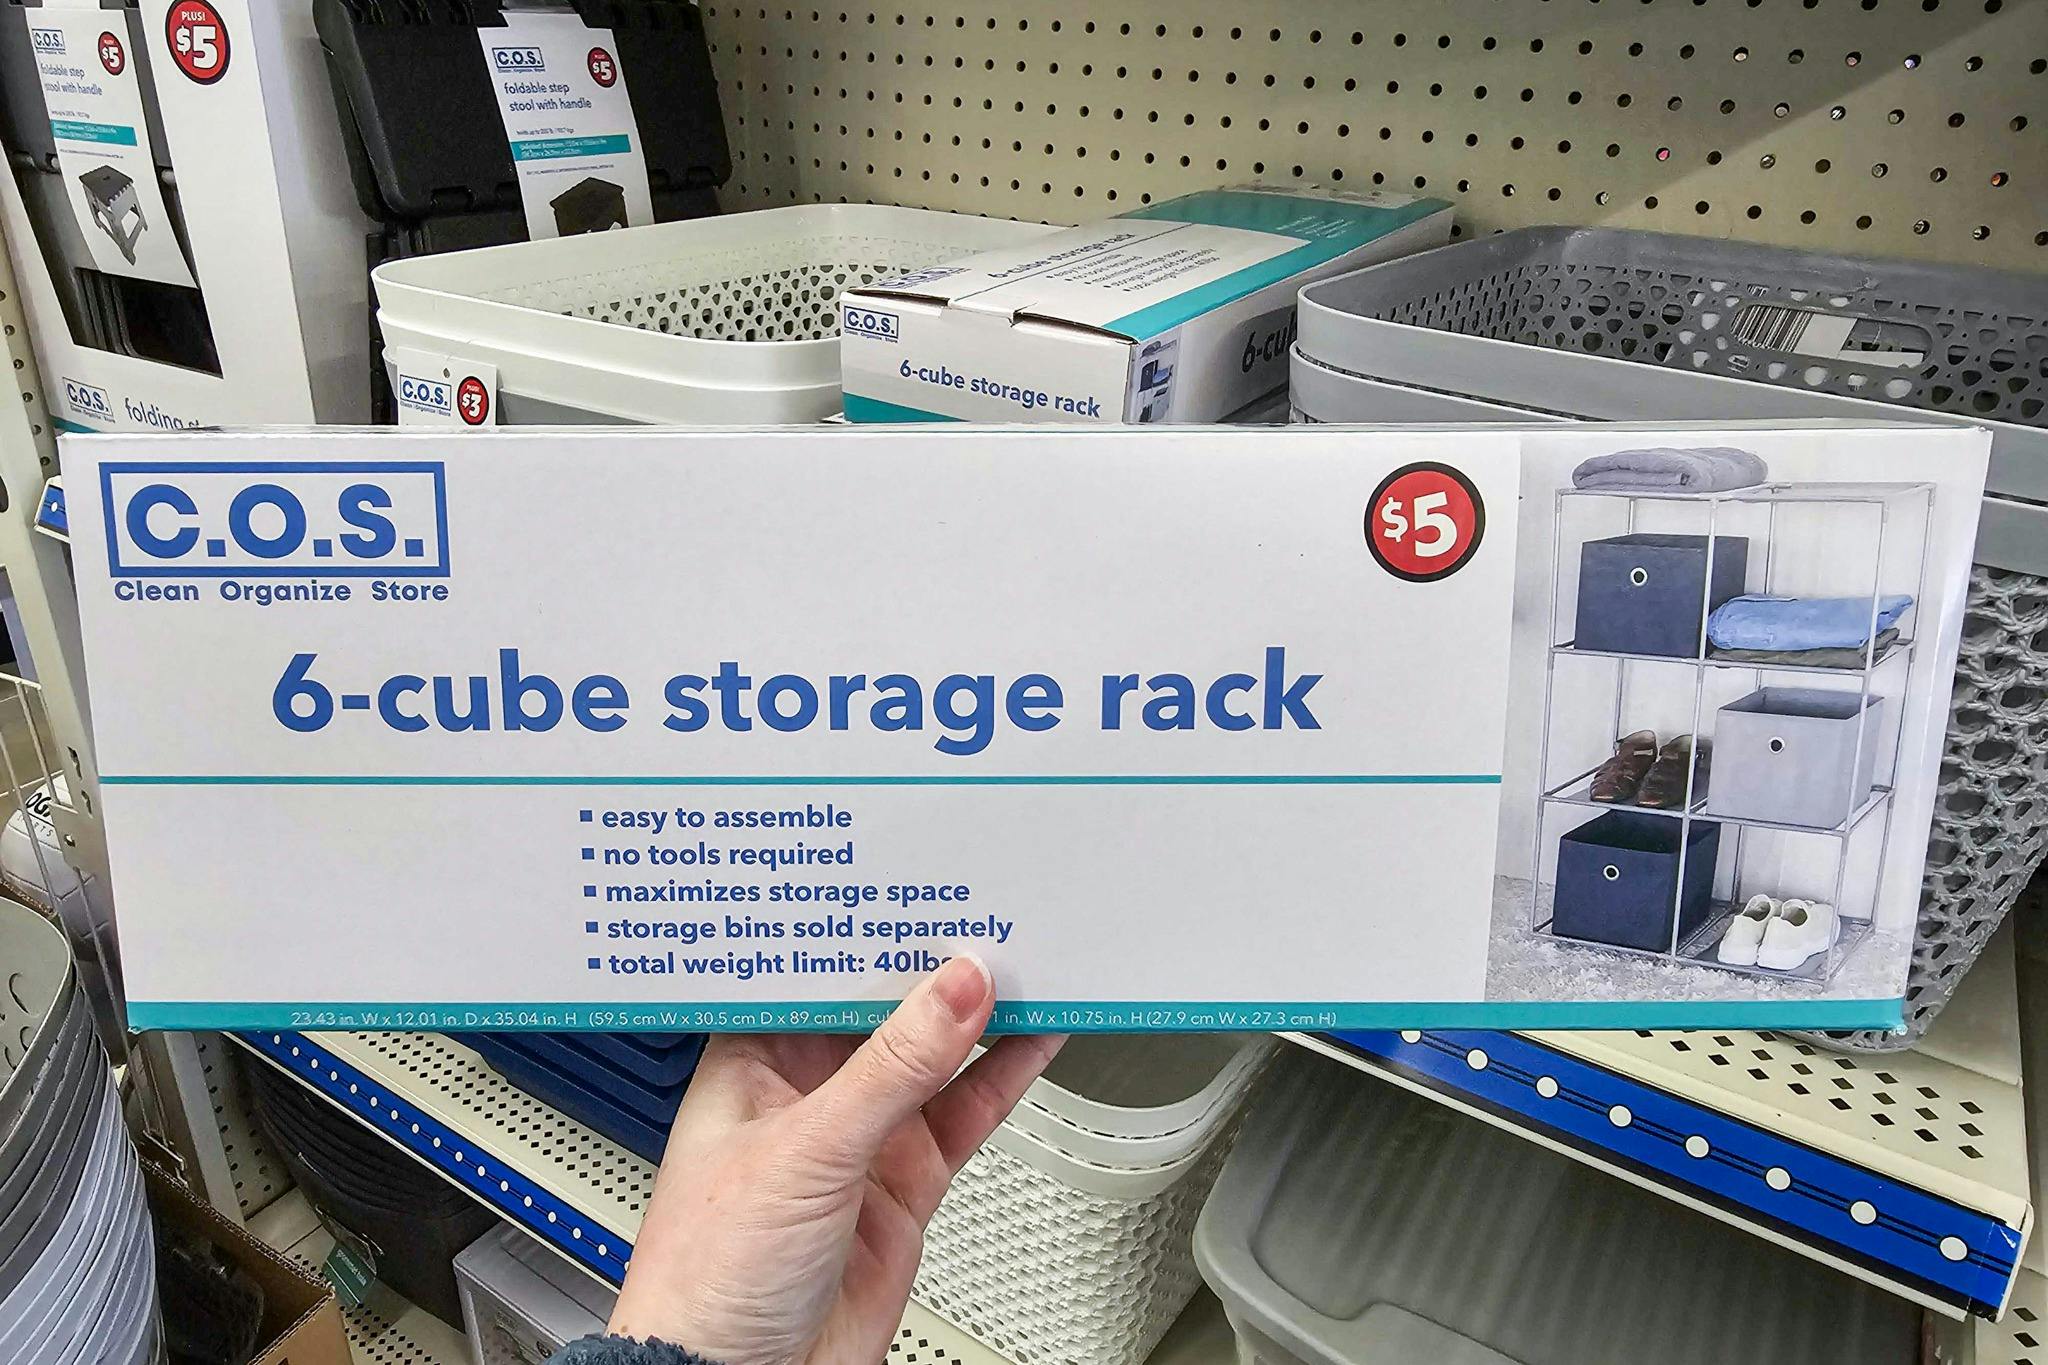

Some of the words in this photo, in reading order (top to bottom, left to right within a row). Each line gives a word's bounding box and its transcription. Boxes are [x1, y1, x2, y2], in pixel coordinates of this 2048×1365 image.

[181, 11, 206, 21] PLUS!
[102, 46, 120, 68] $5
[176, 24, 218, 69] $5
[497, 50, 541, 66] C.O.S.
[592, 61, 612, 81] $5
[504, 82, 547, 95] foldable
[549, 83, 570, 96] step
[509, 99, 535, 112] stool
[536, 98, 557, 110] with
[559, 97, 592, 110] handle
[848, 311, 895, 335] C.O.S.
[67, 383, 110, 412] C.O.S.
[403, 380, 448, 406] C.O.S.
[900, 359, 965, 389] 6-cube
[970, 377, 1049, 409] storage
[1055, 396, 1102, 418] rack
[462, 393, 482, 418] $3
[125, 483, 424, 559] C.O.S.
[1381, 491, 1459, 557] $5
[114, 580, 200, 601] Clean
[219, 580, 352, 606] Organize
[371, 580, 449, 601] Store
[272, 648, 630, 733] 6-cube
[663, 661, 1065, 756] storage
[1101, 646, 1325, 731] rack
[601, 809, 668, 834] easy
[675, 808, 705, 828] to
[713, 804, 852, 829] assemble
[603, 846, 641, 866] no
[648, 842, 721, 866] tools
[729, 842, 854, 871] required
[605, 879, 760, 902] maximizes
[768, 881, 878, 908] storage
[886, 884, 970, 908] space
[607, 919, 716, 944] storage
[725, 916, 785, 939] bins
[793, 914, 854, 938] sold
[862, 914, 1013, 944] separately
[609, 951, 675, 974] total
[683, 951, 784, 980] weight
[792, 951, 866, 974] limit:
[291, 1011, 336, 1026] 23.43
[339, 1012, 358, 1026] in.
[361, 1012, 379, 1026] W
[382, 1016, 392, 1026] x
[396, 1011, 437, 1026] 12.01
[442, 1011, 461, 1026] in.
[465, 1012, 478, 1026] D
[481, 1016, 491, 1026] x
[494, 1011, 538, 1026] 35.04
[543, 1011, 561, 1025] in.
[565, 1012, 577, 1026] H
[588, 1011, 629, 1028] (59.5
[632, 1014, 657, 1026] cm
[659, 1012, 678, 1025] W
[681, 1015, 690, 1025] x
[693, 1011, 728, 1026] 30.5
[732, 1014, 756, 1026] cm
[760, 1011, 773, 1025] D
[777, 1015, 786, 1025] x
[790, 1011, 810, 1025] 89
[814, 1014, 838, 1026] cm
[842, 1010, 860, 1027] H)
[1005, 1011, 1023, 1025] in.
[1026, 1011, 1044, 1025] W
[1047, 1015, 1056, 1025] x
[1061, 1010, 1104, 1025] 10.75
[1108, 1011, 1127, 1025] in.
[1190, 1014, 1214, 1026] cm
[1218, 1011, 1237, 1025] W
[1239, 1015, 1248, 1025] x
[1251, 1011, 1286, 1026] 27.3
[1290, 1014, 1314, 1026] cm
[1318, 1011, 1337, 1028] H)
